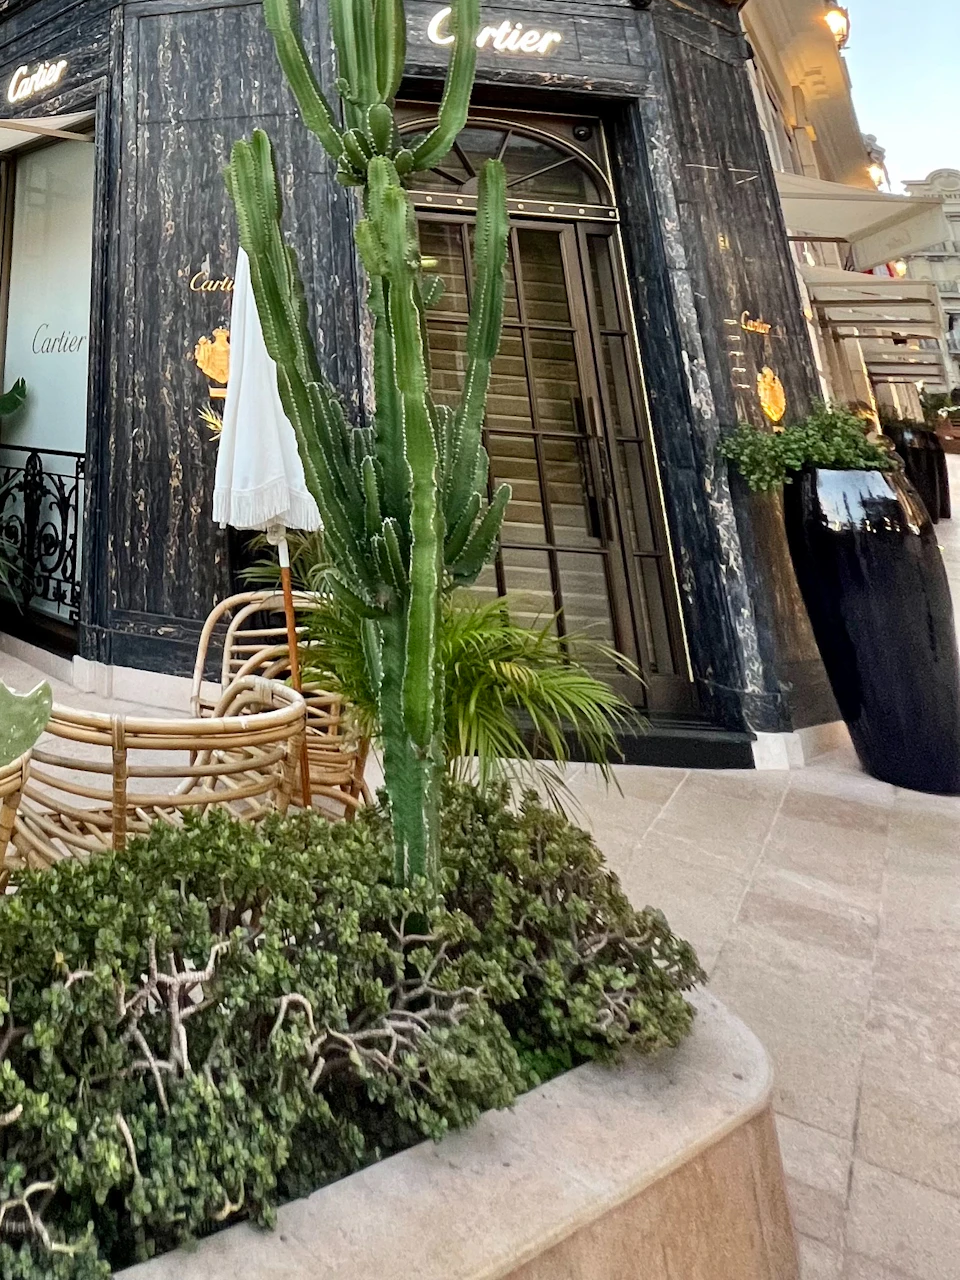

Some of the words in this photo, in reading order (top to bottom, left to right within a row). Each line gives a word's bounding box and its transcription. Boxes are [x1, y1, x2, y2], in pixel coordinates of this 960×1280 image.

[427, 6, 562, 53] Crtier
[7, 60, 67, 103] Cartier
[190, 271, 235, 292] Carti
[32, 323, 87, 355] Cartier
